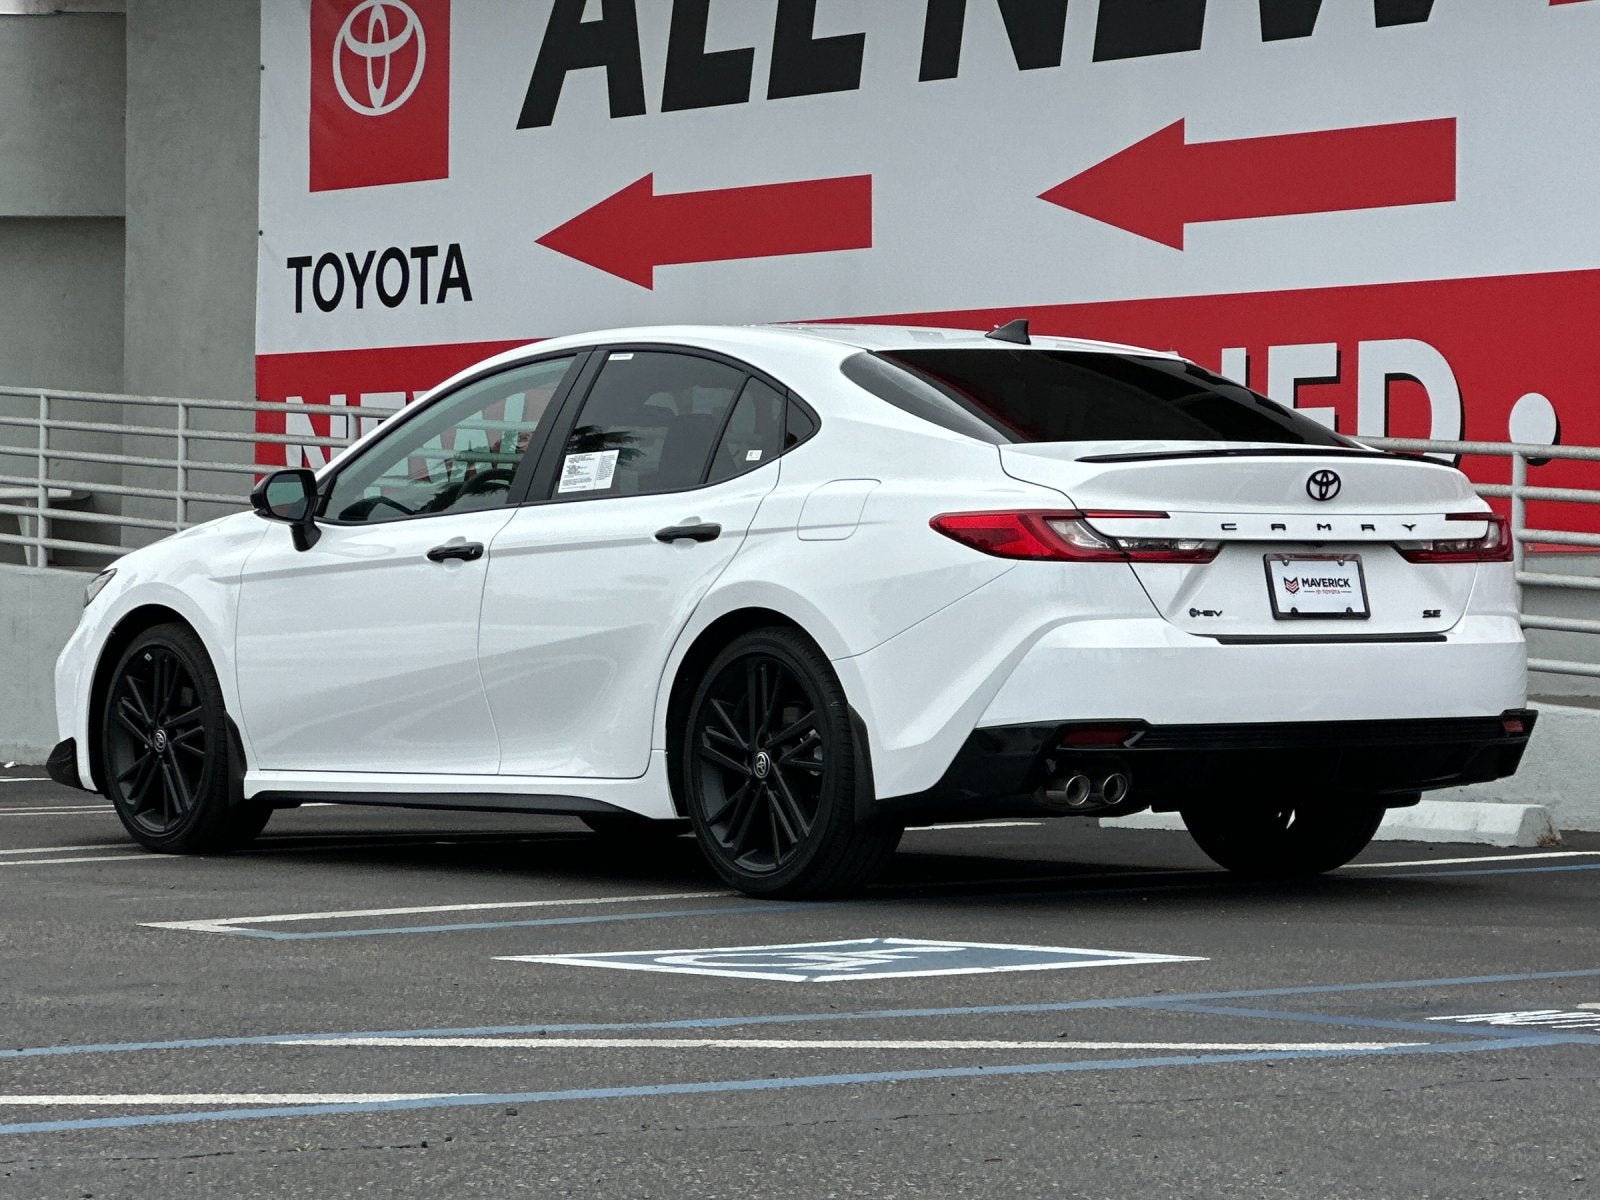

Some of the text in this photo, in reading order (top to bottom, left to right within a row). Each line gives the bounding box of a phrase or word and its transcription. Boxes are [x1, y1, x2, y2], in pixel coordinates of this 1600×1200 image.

[287, 243, 472, 313] TOYOTA
[1220, 523, 1416, 532] CAMRY
[1301, 578, 1351, 588] MAVERICK
[1422, 609, 1442, 618] SE
